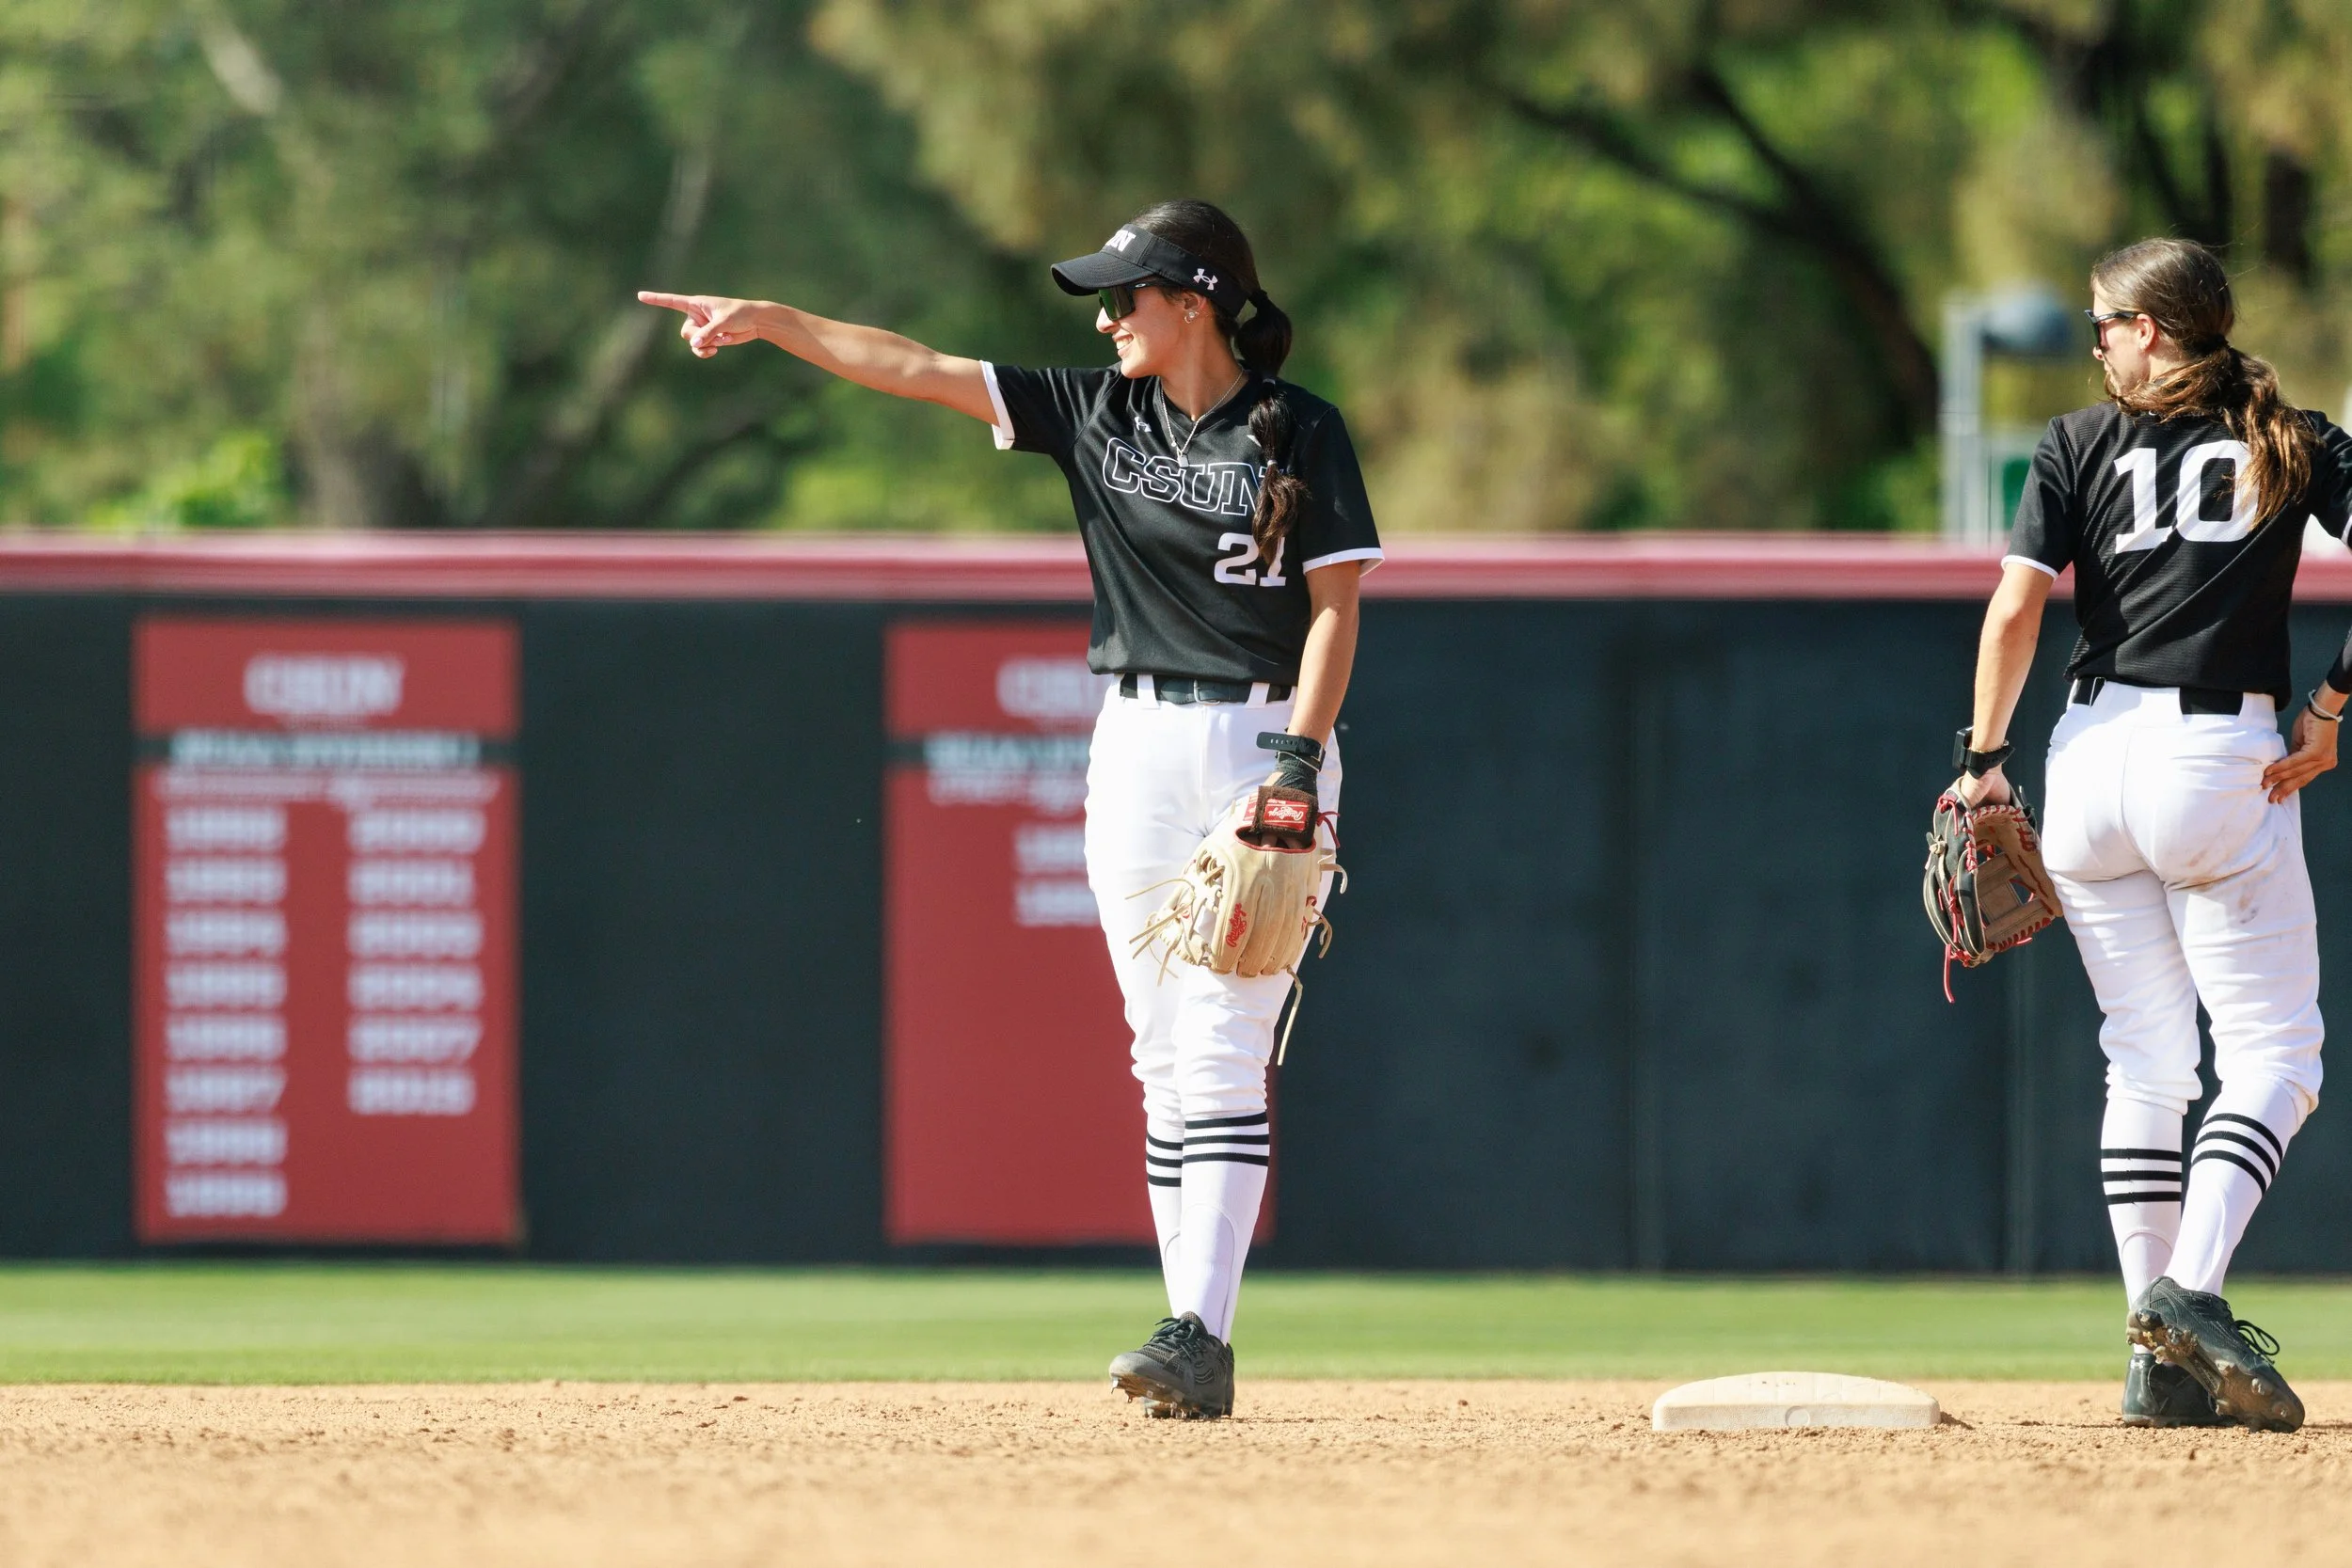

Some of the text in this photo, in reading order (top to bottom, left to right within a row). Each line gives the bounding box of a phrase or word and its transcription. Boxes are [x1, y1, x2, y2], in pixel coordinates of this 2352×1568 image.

[1103, 437, 1283, 516] CSUN
[2114, 439, 2261, 554] 10
[1214, 532, 1287, 587] 21
[1268, 807, 1304, 821] Rawlings
[1226, 903, 1247, 947] Rawlings
